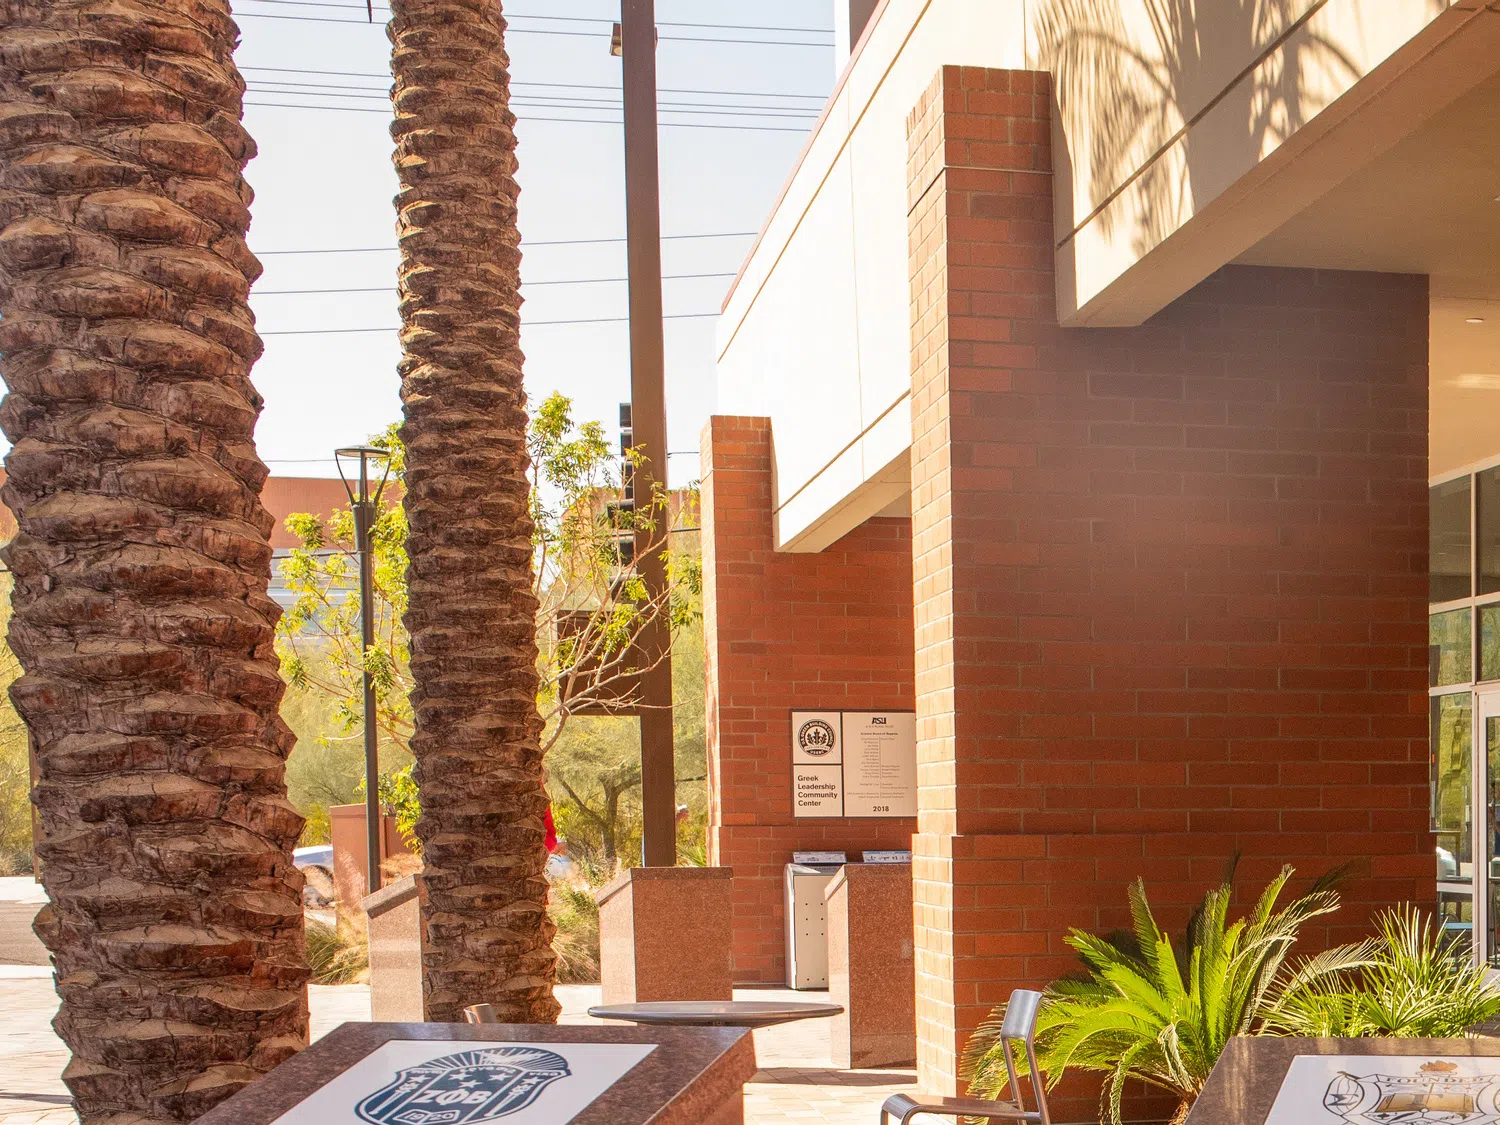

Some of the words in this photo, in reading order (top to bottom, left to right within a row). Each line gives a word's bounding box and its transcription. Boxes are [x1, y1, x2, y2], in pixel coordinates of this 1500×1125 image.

[872, 717, 887, 725] ASU
[797, 783, 836, 791] Leadership
[797, 791, 838, 799] Community
